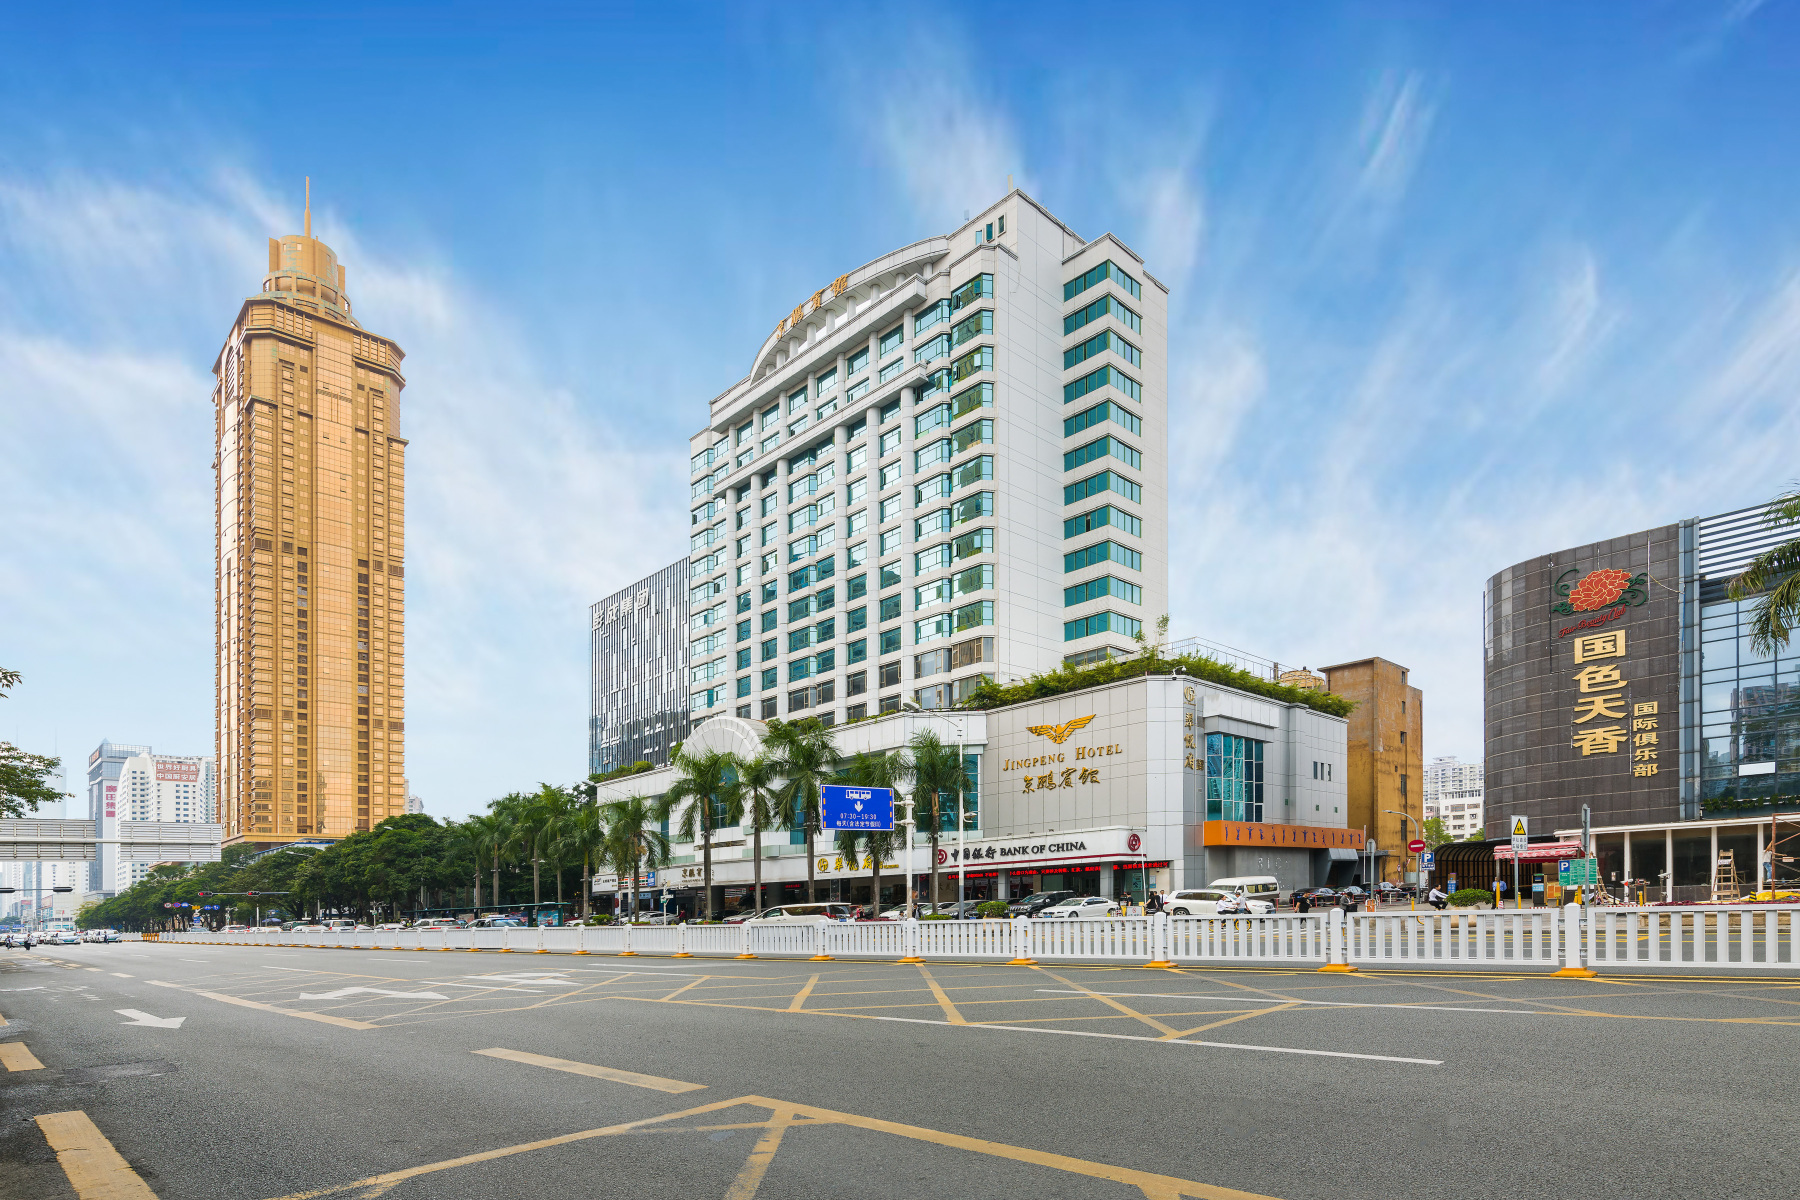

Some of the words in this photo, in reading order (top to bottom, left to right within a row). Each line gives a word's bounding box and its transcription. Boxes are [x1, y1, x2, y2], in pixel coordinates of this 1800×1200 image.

[1577, 613, 1609, 630] Beauty
[1607, 603, 1626, 621] Club
[1572, 629, 1628, 757] 国色天香
[1633, 701, 1659, 778] 国际俱乐部
[1000, 846, 1030, 857] BANK
[1031, 844, 1046, 855] OF
[1048, 841, 1087, 853] CHINA
[1424, 853, 1432, 863] P
[1561, 862, 1569, 871] P
